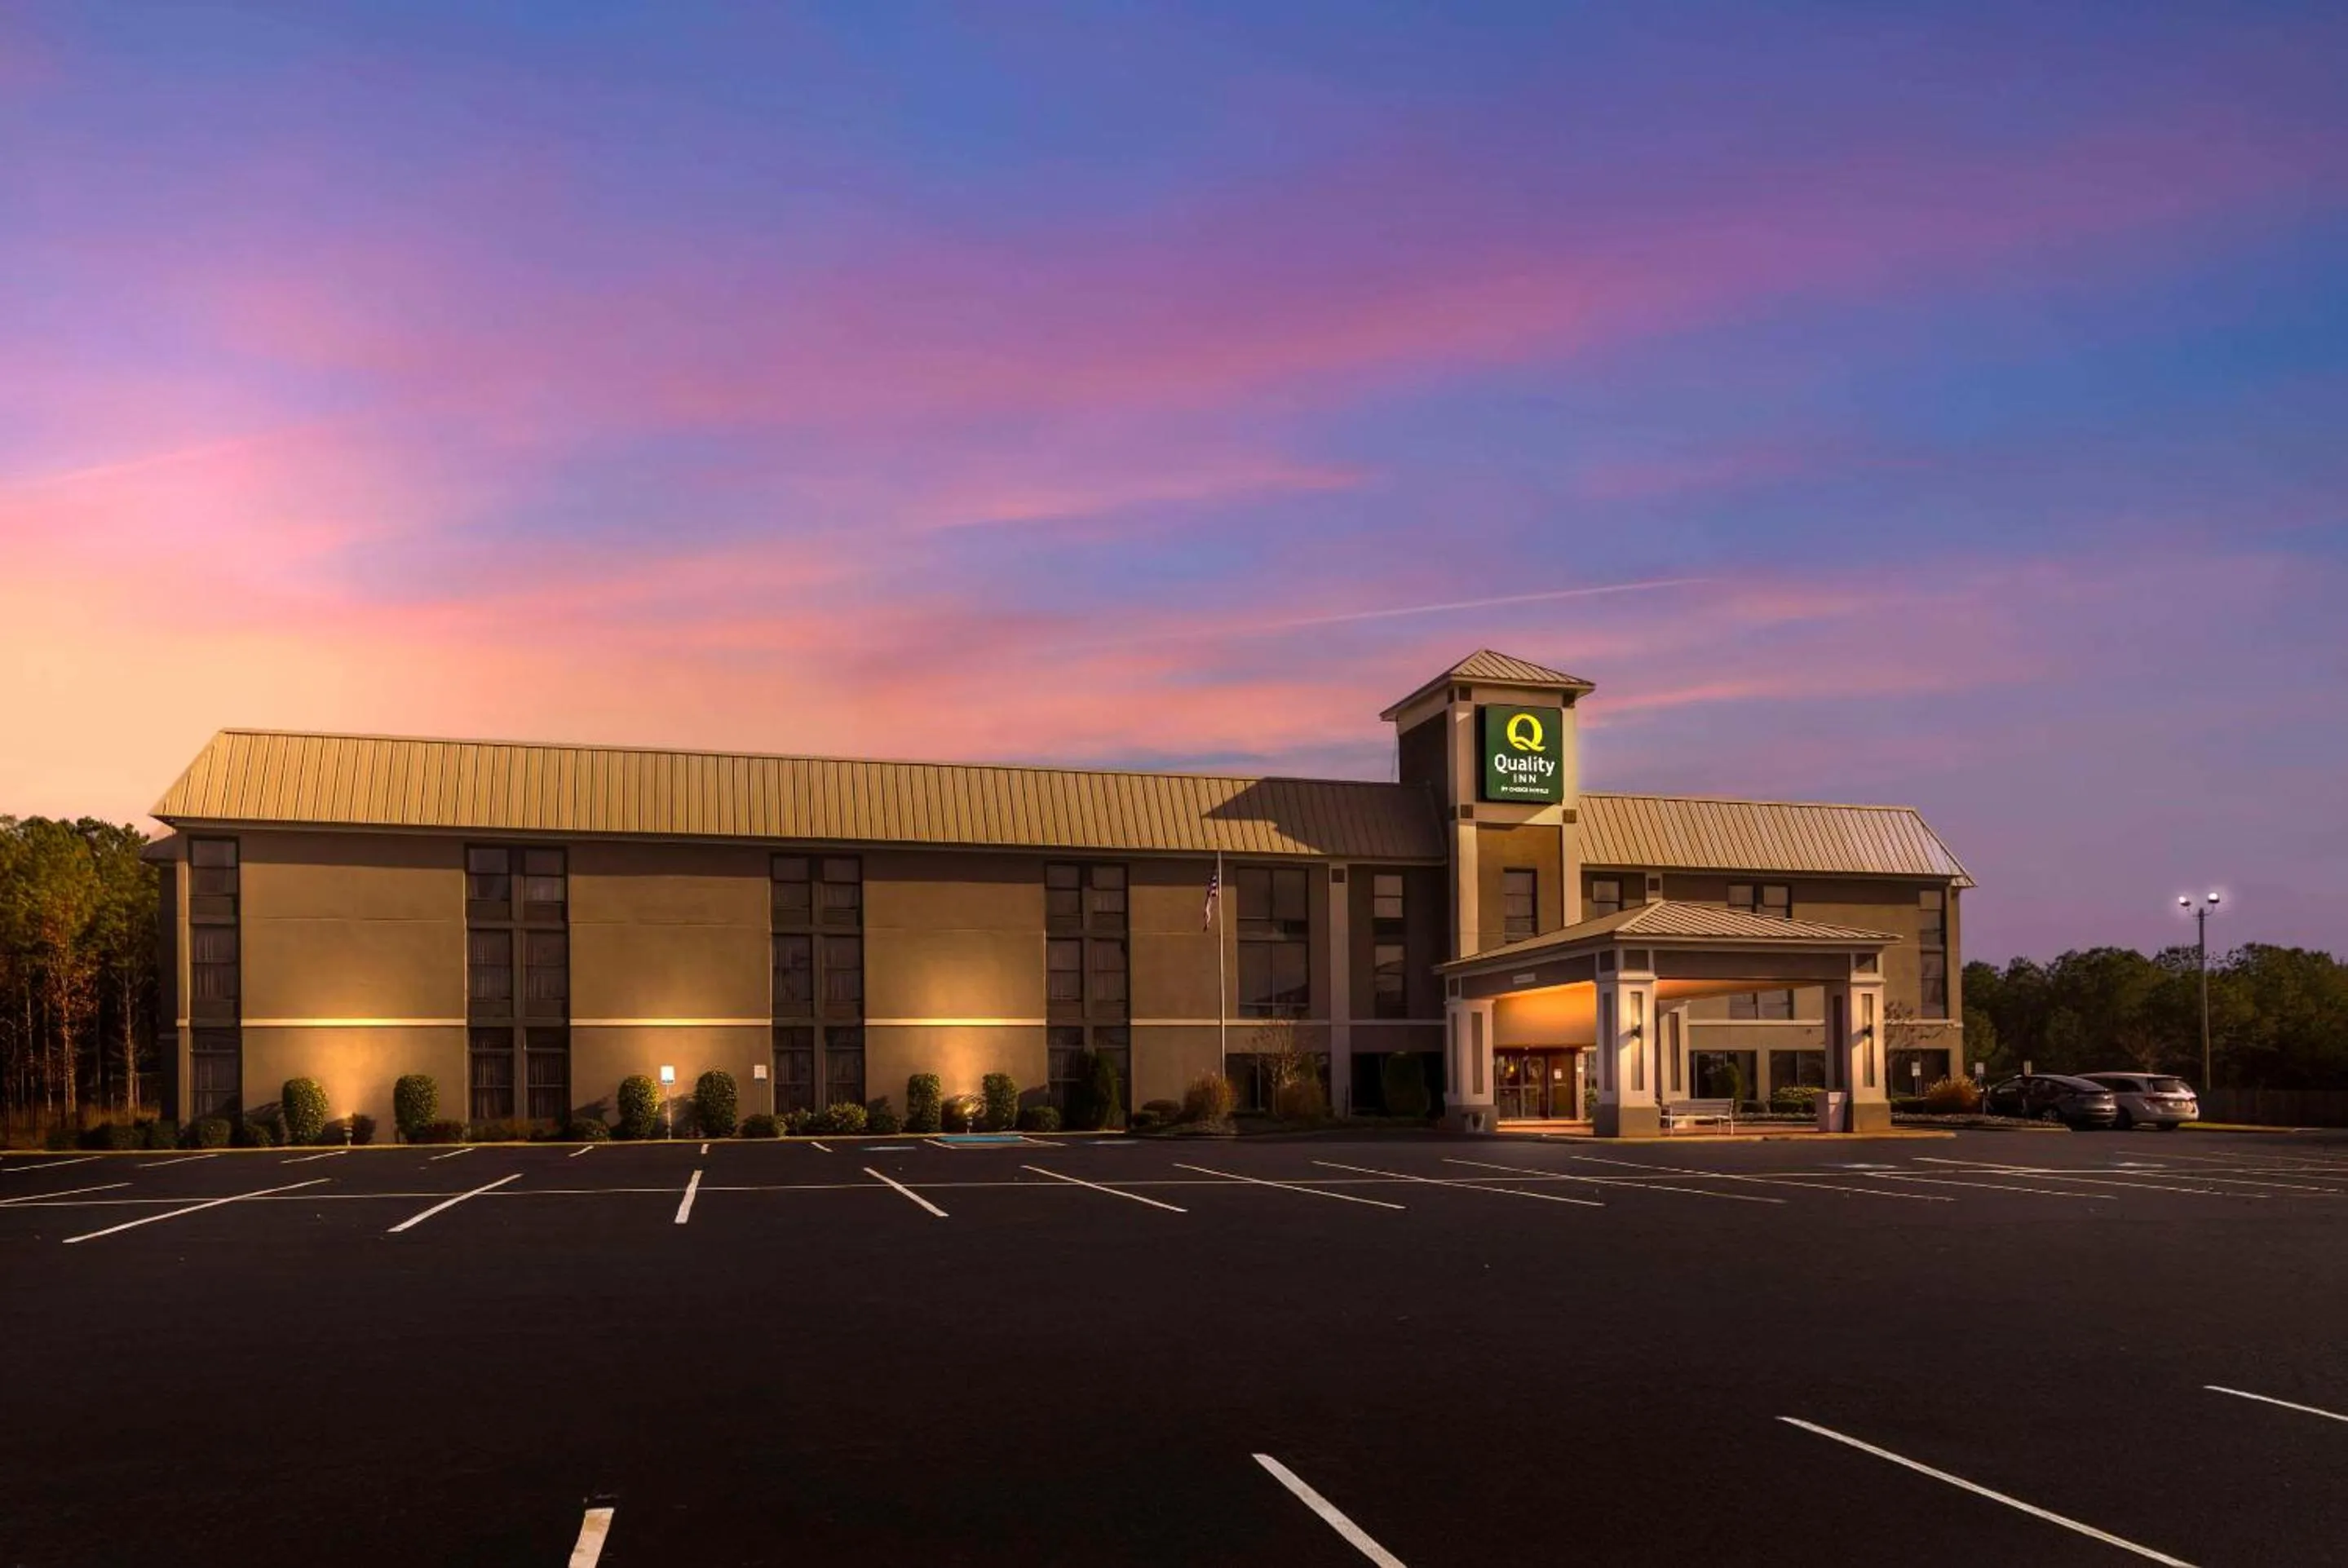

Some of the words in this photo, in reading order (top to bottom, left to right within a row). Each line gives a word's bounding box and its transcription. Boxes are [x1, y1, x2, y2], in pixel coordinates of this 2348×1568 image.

[1506, 713, 1546, 752] Q
[1494, 753, 1555, 777] Quality
[1513, 774, 1537, 784] INN
